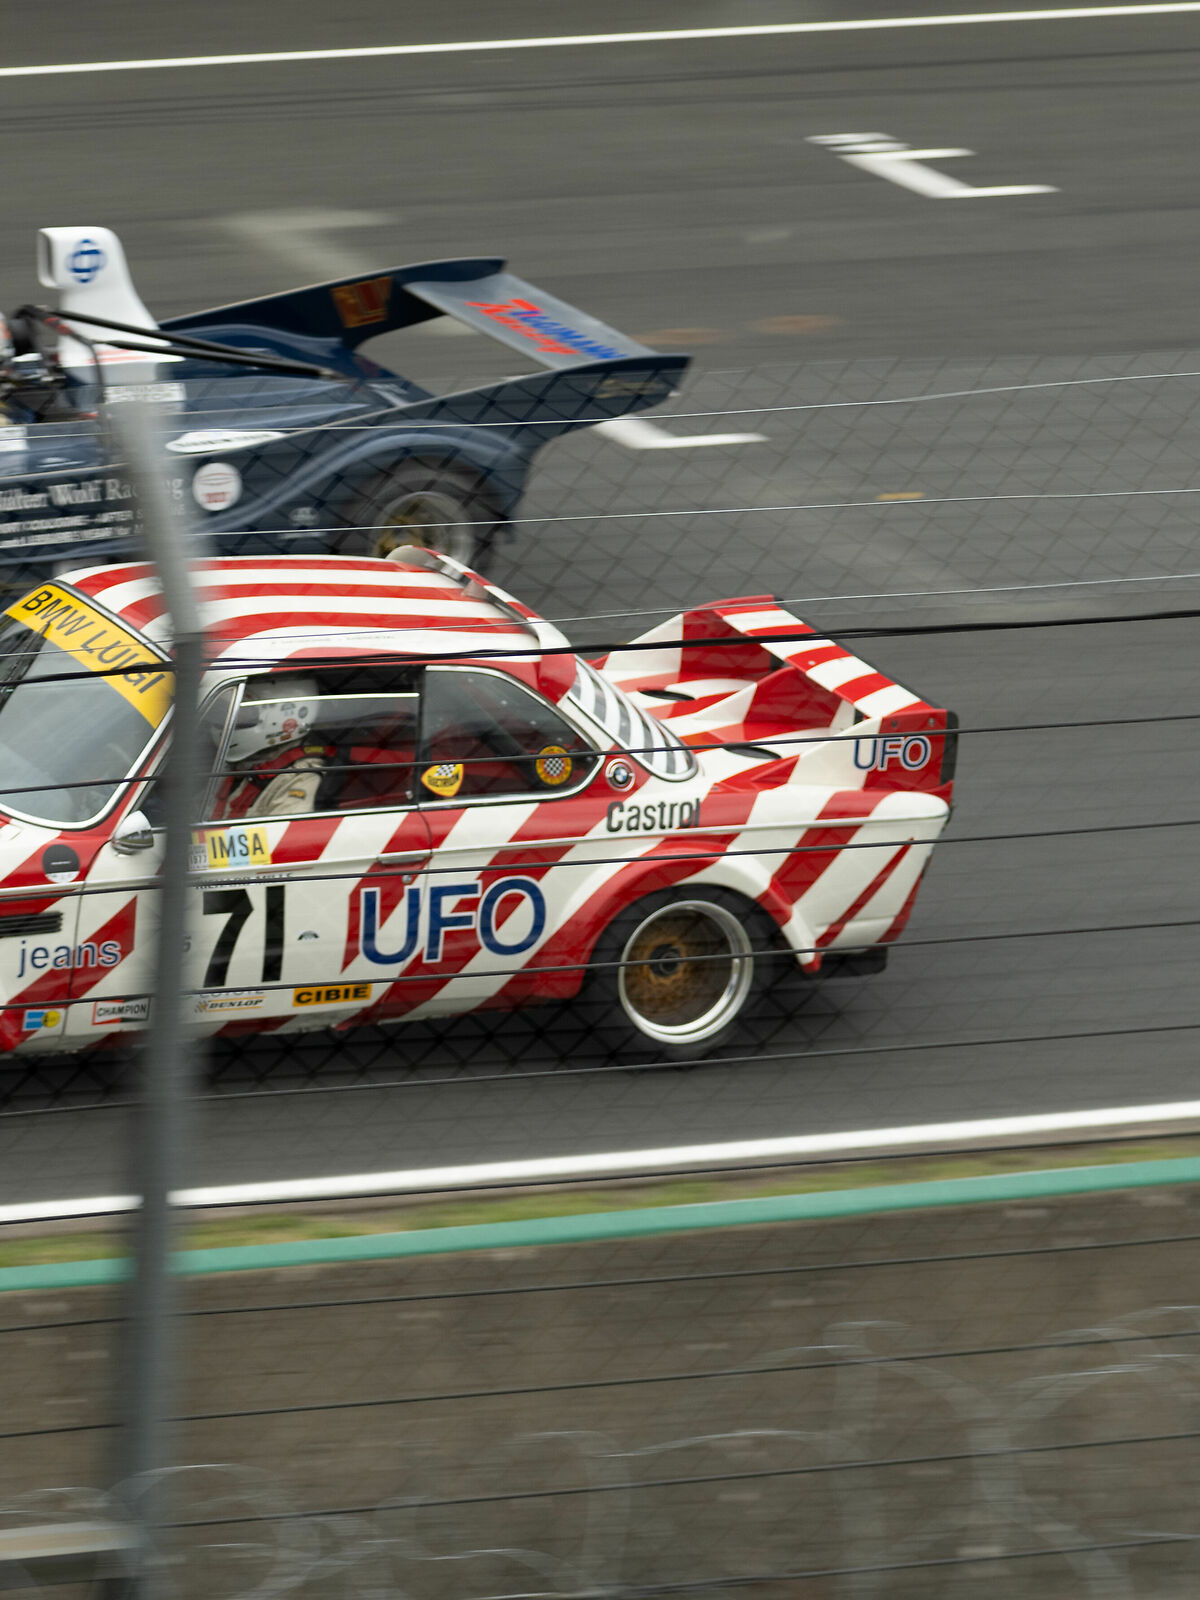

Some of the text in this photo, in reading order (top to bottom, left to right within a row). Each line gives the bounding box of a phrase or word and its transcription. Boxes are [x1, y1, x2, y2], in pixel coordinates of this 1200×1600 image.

[22, 590, 166, 694] BMW LUIGI
[854, 736, 931, 771] UFO
[606, 797, 701, 833] Castrol
[210, 832, 265, 860] IMSA
[202, 884, 286, 988] 71
[360, 874, 547, 966] UFO
[17, 940, 121, 978] jeans
[97, 1003, 147, 1017] CHAMPION
[208, 999, 264, 1009] DUNLOP
